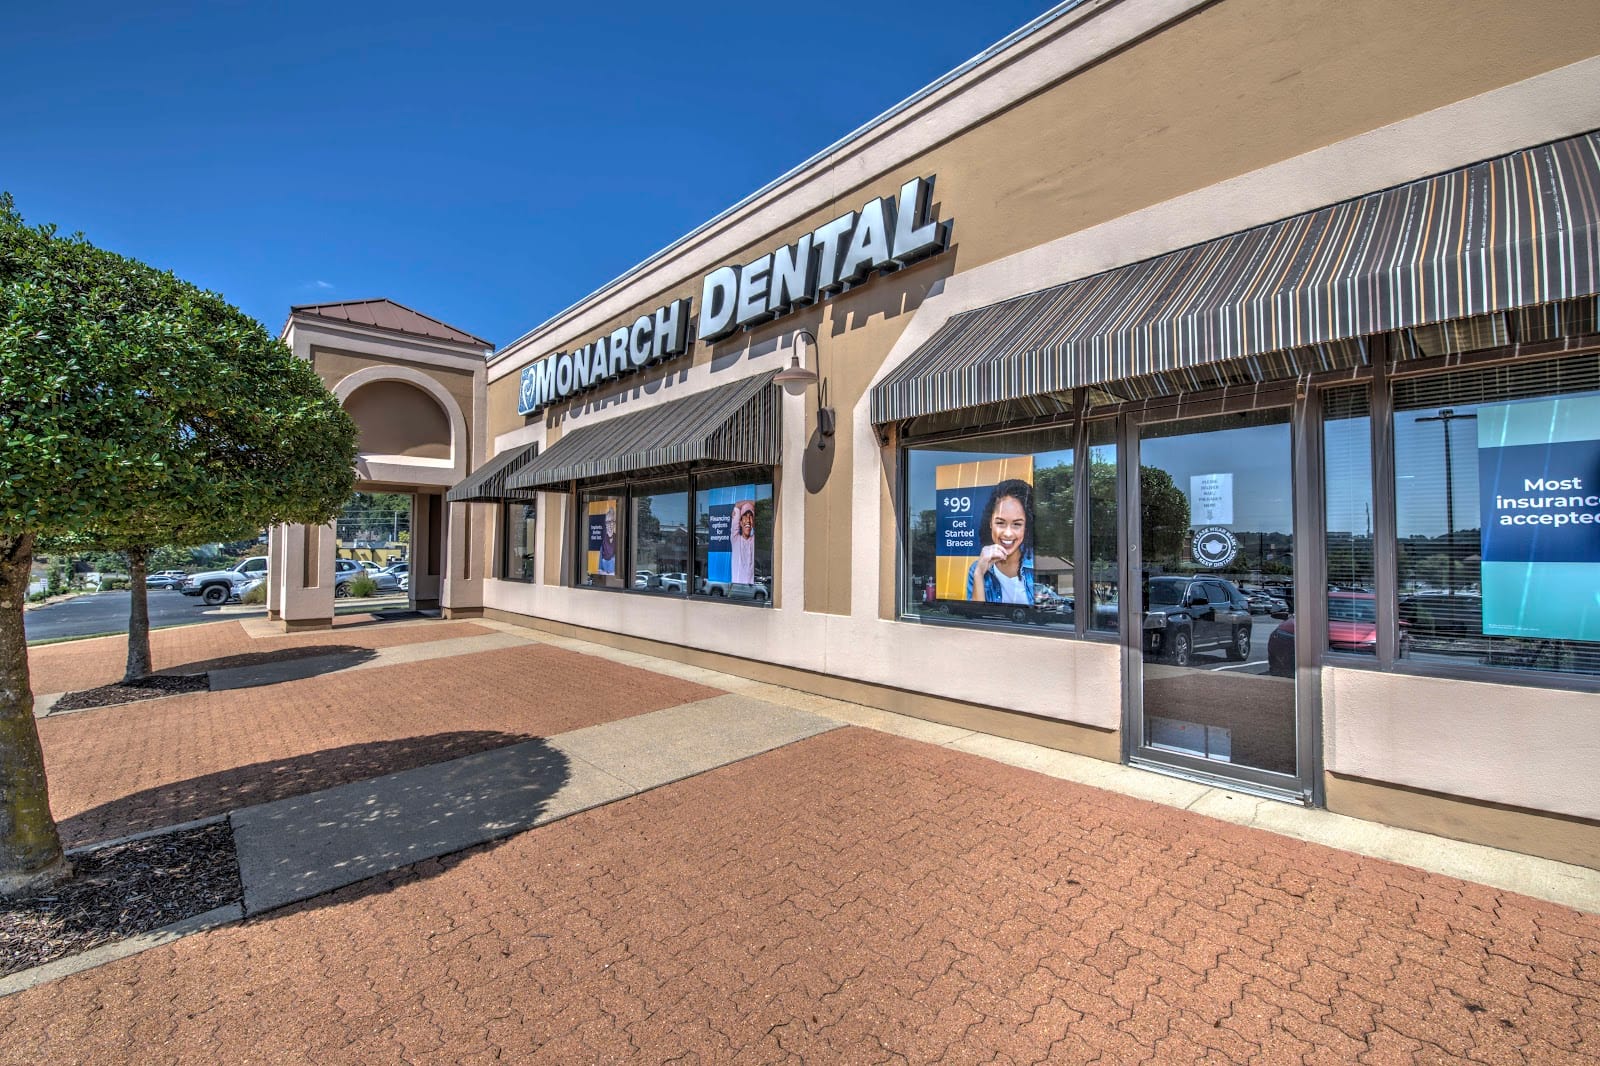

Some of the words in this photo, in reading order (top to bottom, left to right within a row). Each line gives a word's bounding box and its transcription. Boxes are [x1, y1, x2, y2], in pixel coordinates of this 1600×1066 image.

[533, 299, 690, 405] MONARCH
[698, 177, 945, 343] DENTAL
[1524, 477, 1583, 492] Most
[943, 496, 971, 513] $99
[1496, 495, 1600, 510] insuranc
[711, 522, 728, 530] options
[952, 520, 967, 528] Get
[944, 529, 975, 538] Started
[1193, 528, 1209, 544] PLEASE
[946, 540, 974, 548] Braces
[1198, 558, 1213, 567] KEEP
